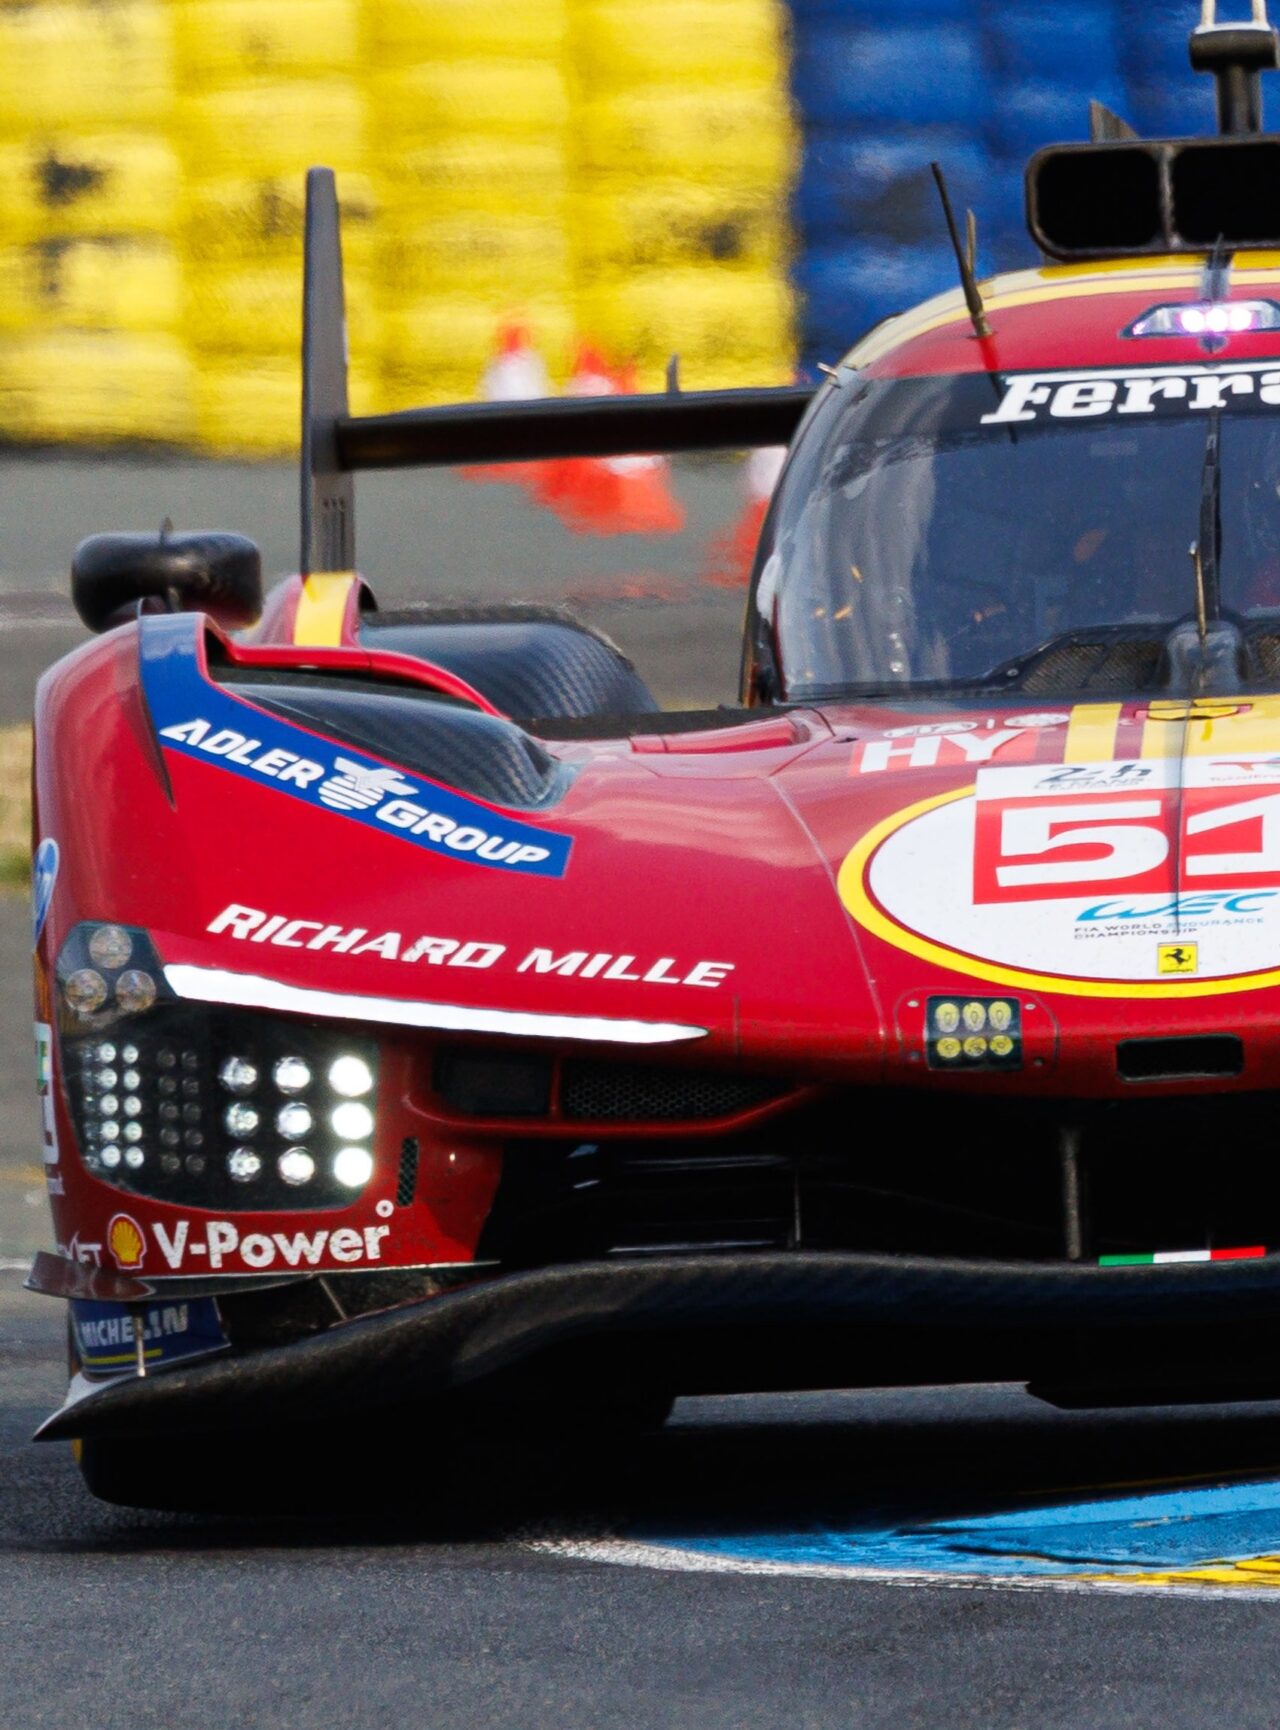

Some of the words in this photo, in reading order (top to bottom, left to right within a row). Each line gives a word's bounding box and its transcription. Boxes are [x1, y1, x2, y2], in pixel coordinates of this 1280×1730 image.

[859, 728, 1027, 773] HY
[159, 718, 325, 789] ADLER
[375, 799, 551, 865] GROUP
[1074, 891, 1279, 923] WEC
[1104, 922, 1163, 931] WORLD
[1167, 916, 1266, 929] ENDURANCE
[206, 903, 506, 969] RICHARD
[517, 946, 735, 988] MILLE
[1073, 927, 1199, 940] CHAMPIONSHIP
[152, 1219, 391, 1270] V-Power
